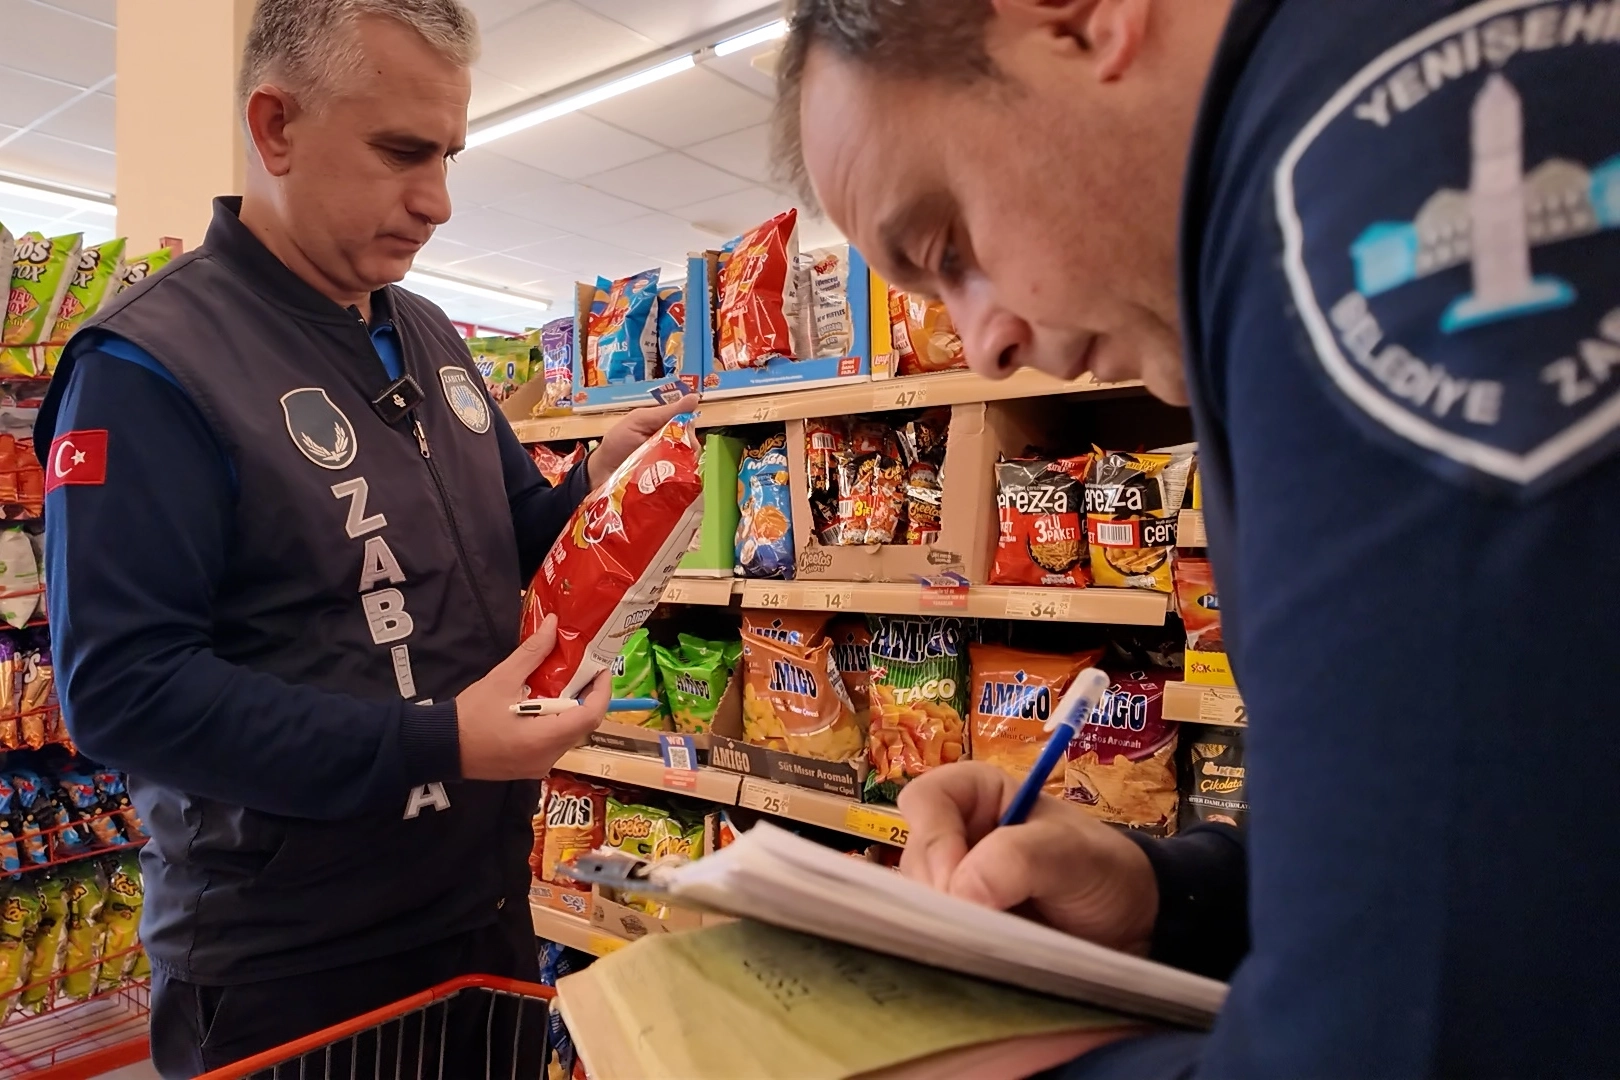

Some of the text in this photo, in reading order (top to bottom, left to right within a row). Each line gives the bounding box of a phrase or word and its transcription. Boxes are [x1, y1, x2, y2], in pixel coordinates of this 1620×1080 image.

[895, 391, 916, 407] 47
[753, 408, 770, 420] 47
[550, 427, 564, 437] 87
[1047, 528, 1075, 542] PAKET
[667, 589, 681, 601] 47
[761, 594, 779, 607] 34
[825, 594, 841, 608] 14
[1030, 602, 1057, 618] 34
[331, 477, 451, 820] ZABIA
[893, 679, 956, 705] TACO
[601, 764, 611, 775] 12
[778, 761, 792, 772] Süt
[817, 769, 853, 785] Aromalı
[1200, 777, 1243, 793] Çikolata
[764, 796, 780, 812] 25
[890, 826, 909, 845] 25
